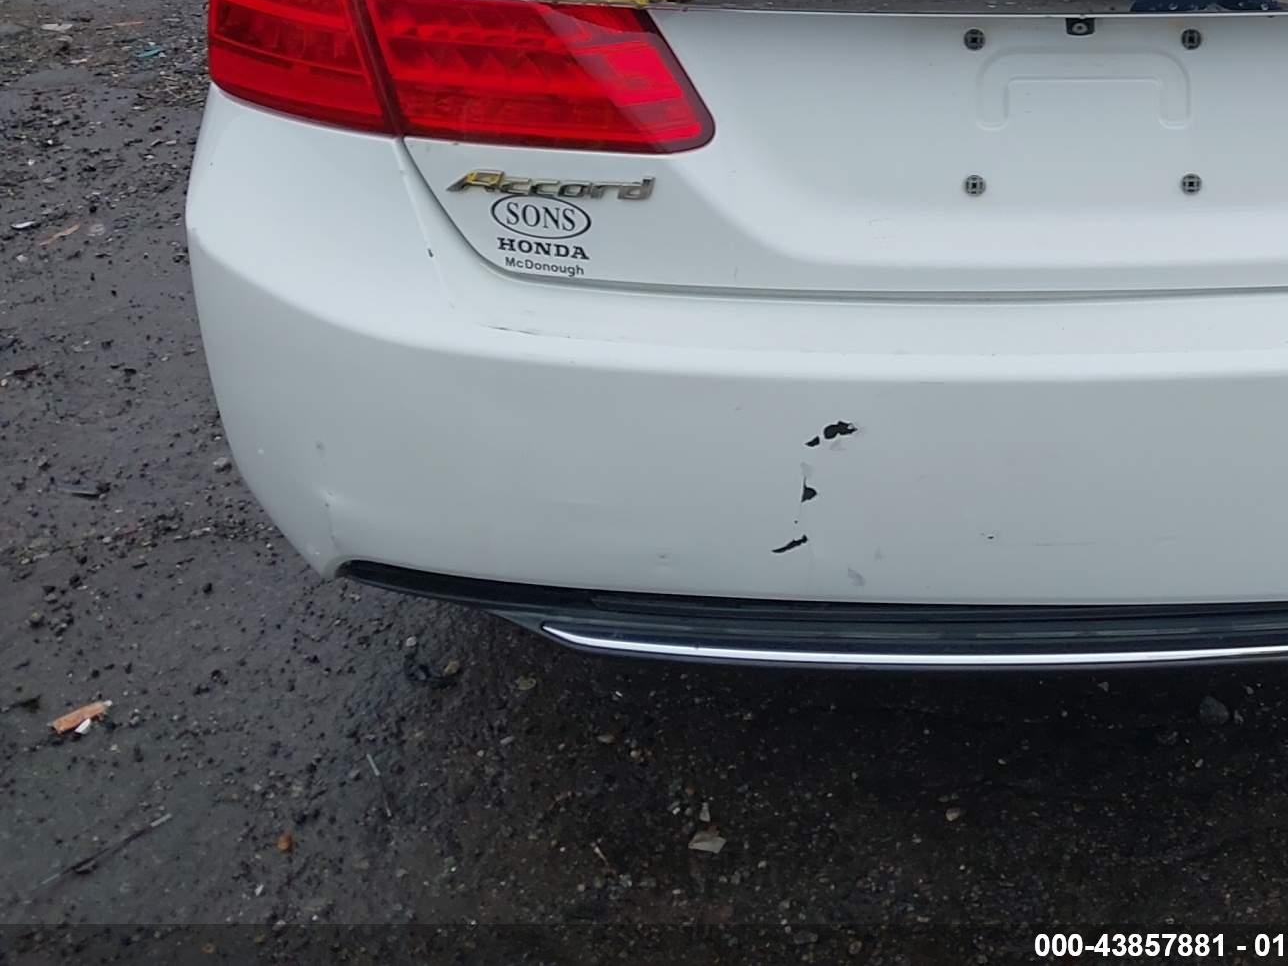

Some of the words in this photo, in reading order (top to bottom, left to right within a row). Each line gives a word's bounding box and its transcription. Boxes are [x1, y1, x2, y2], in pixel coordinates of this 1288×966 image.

[446, 169, 656, 201] Accord
[506, 201, 577, 232] SONS
[496, 237, 590, 261] HONDA
[504, 256, 585, 277] McDonough
